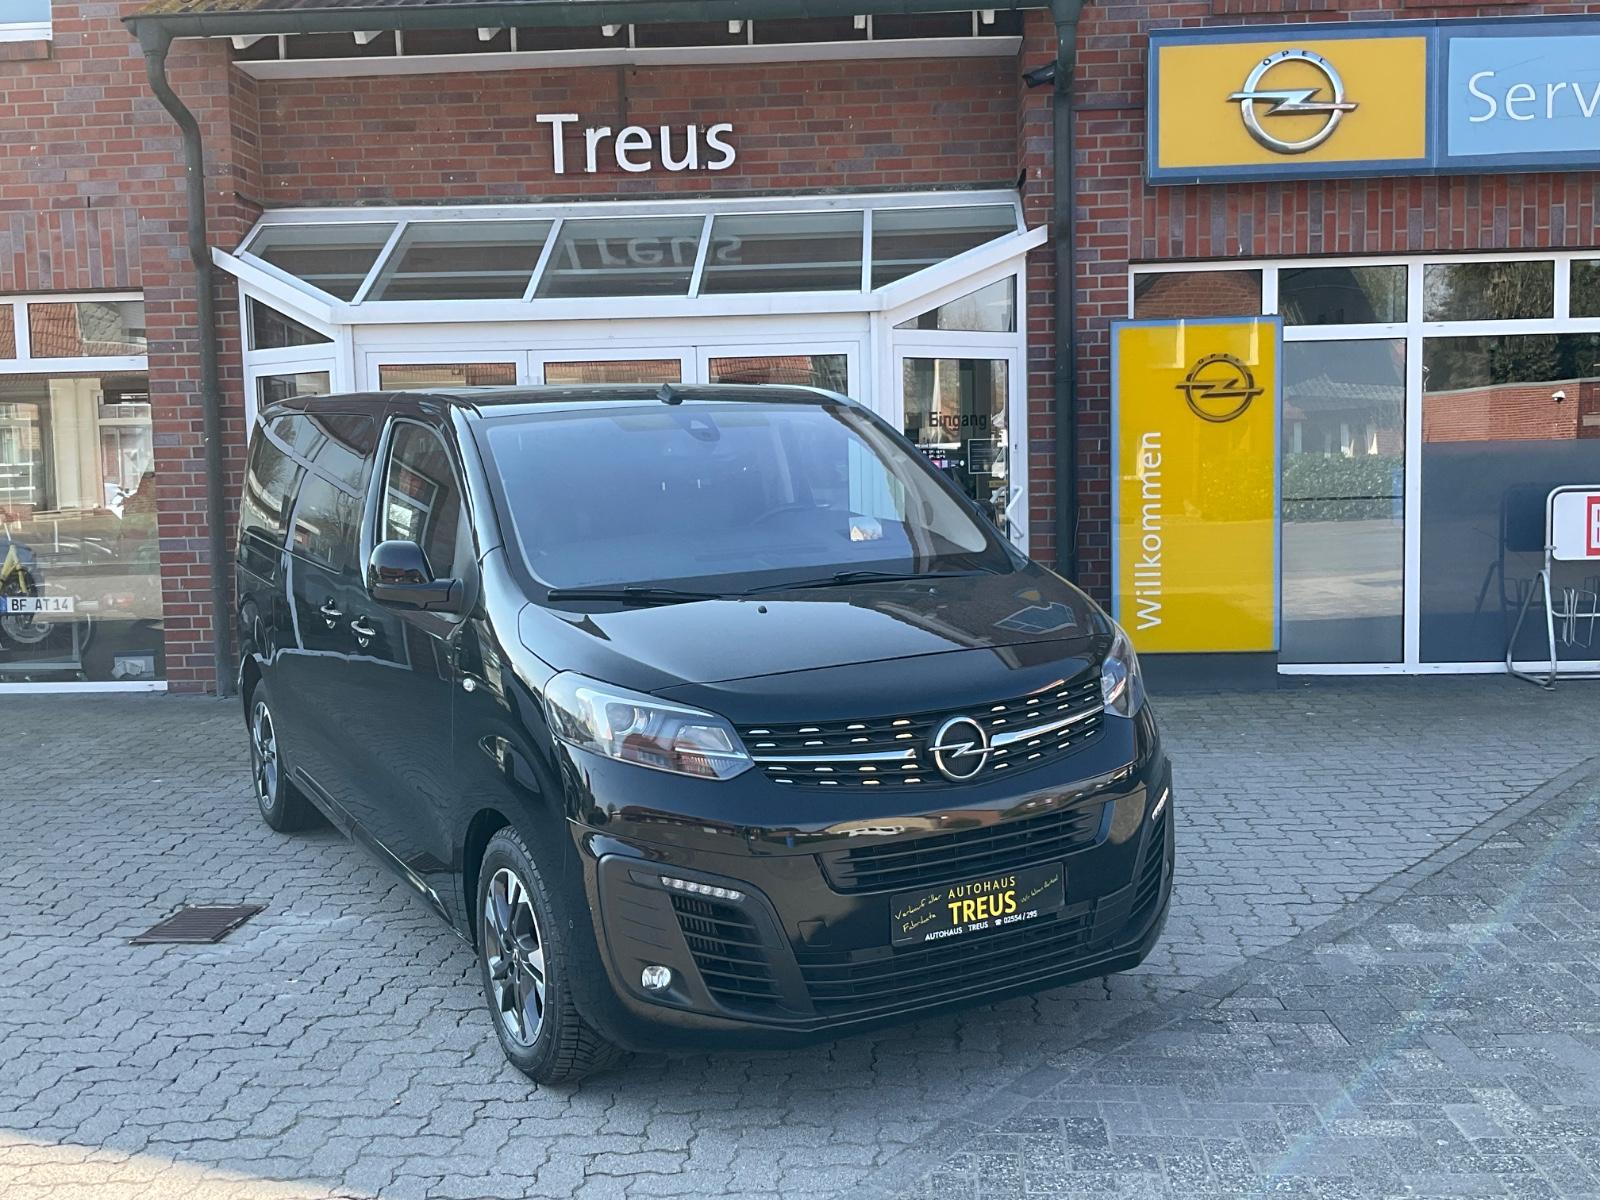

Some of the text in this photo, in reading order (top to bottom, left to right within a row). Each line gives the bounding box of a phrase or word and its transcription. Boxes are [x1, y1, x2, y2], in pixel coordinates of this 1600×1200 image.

[1262, 50, 1325, 66] OPEL
[1468, 71, 1600, 122] Serv
[536, 113, 736, 174] Treus
[928, 411, 987, 432] Eingang
[1134, 432, 1162, 630] Willkommen
[11, 598, 27, 611] BF
[948, 876, 1016, 899] AUTOHAUS
[948, 890, 1017, 925] TREUS
[924, 926, 963, 942] AUTOHAUS
[967, 921, 989, 932] TREUS
